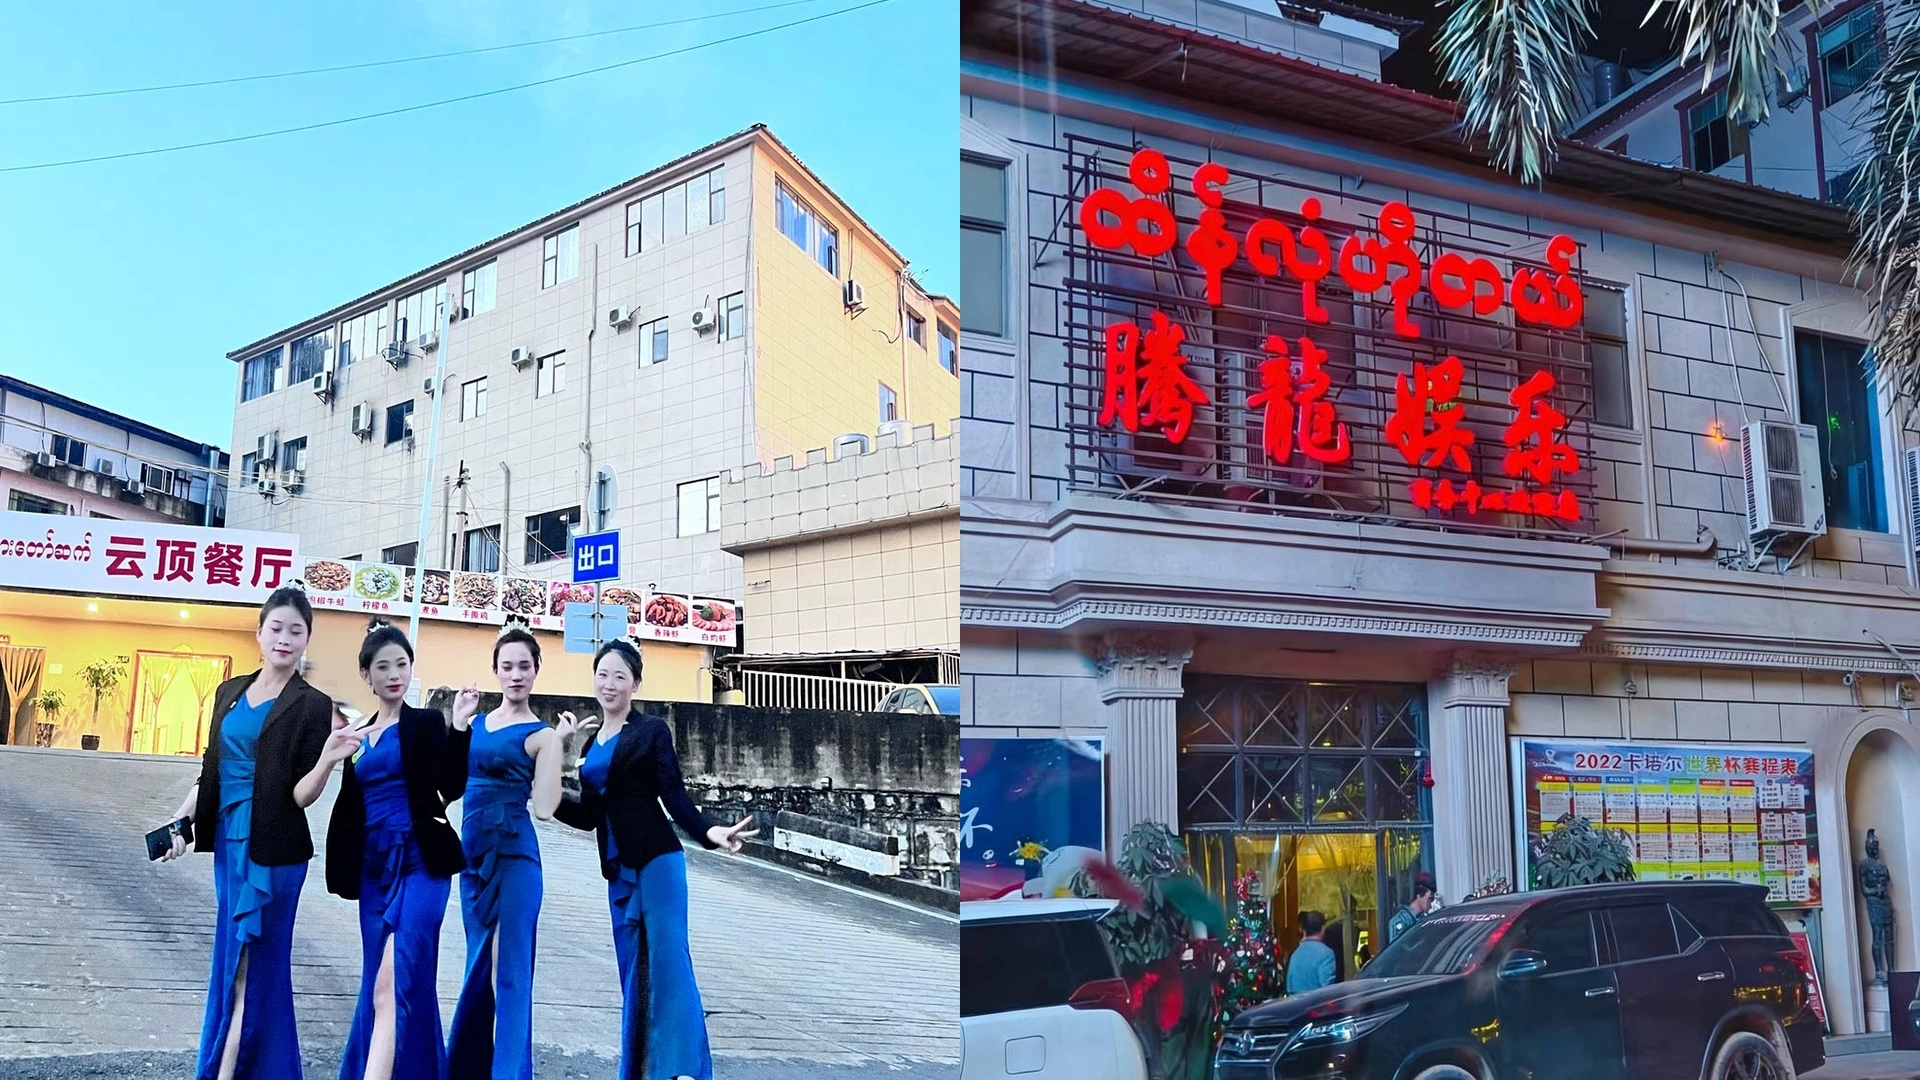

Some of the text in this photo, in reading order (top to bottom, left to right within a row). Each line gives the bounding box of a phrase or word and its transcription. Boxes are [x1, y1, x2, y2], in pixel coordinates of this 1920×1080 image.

[105, 535, 293, 590] 云顶餐厅
[578, 544, 614, 571] 出口
[421, 605, 439, 616] 煮鱼
[462, 609, 489, 621] 手撕鸡
